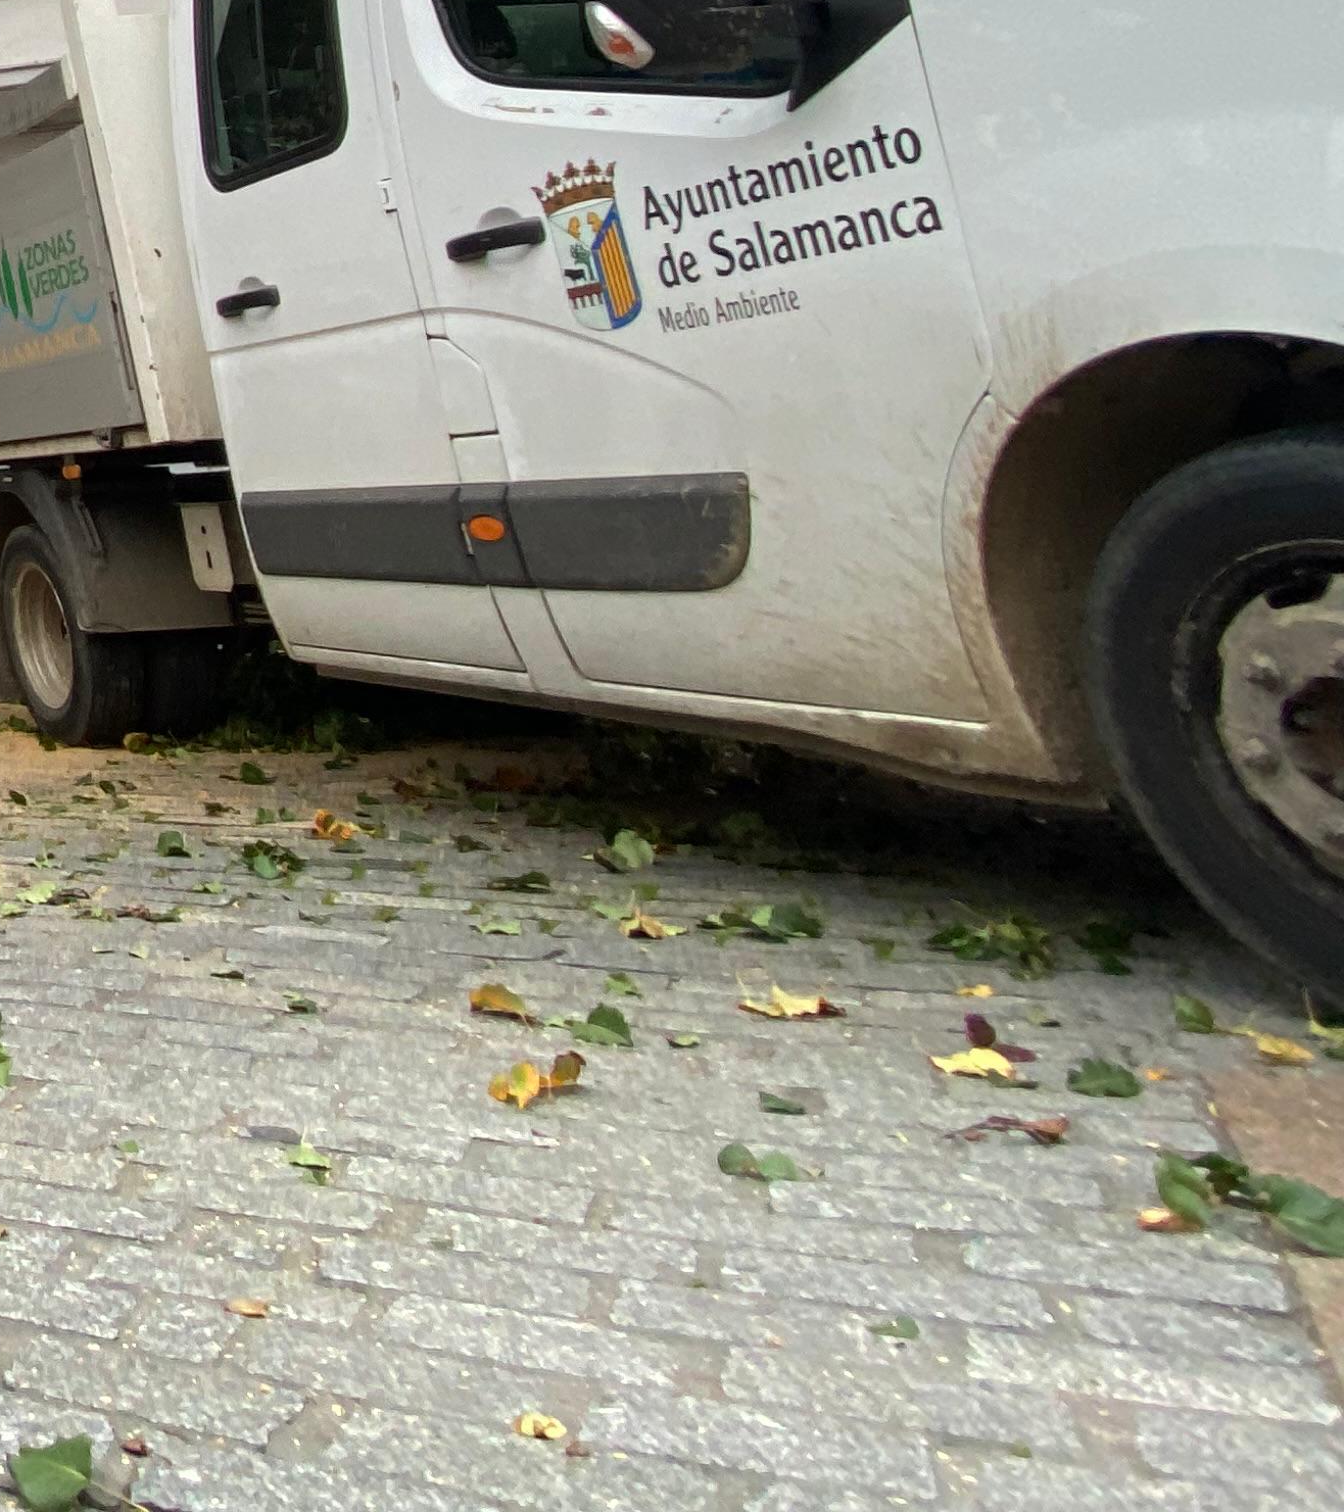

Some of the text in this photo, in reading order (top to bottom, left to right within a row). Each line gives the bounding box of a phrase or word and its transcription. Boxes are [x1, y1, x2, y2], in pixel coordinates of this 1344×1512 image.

[642, 124, 922, 234] Ayuntamiento
[23, 229, 76, 271] ZONAS
[658, 195, 943, 288] de Salamanca
[29, 255, 90, 298] VERDES
[658, 287, 801, 334] Medio Ambiente
